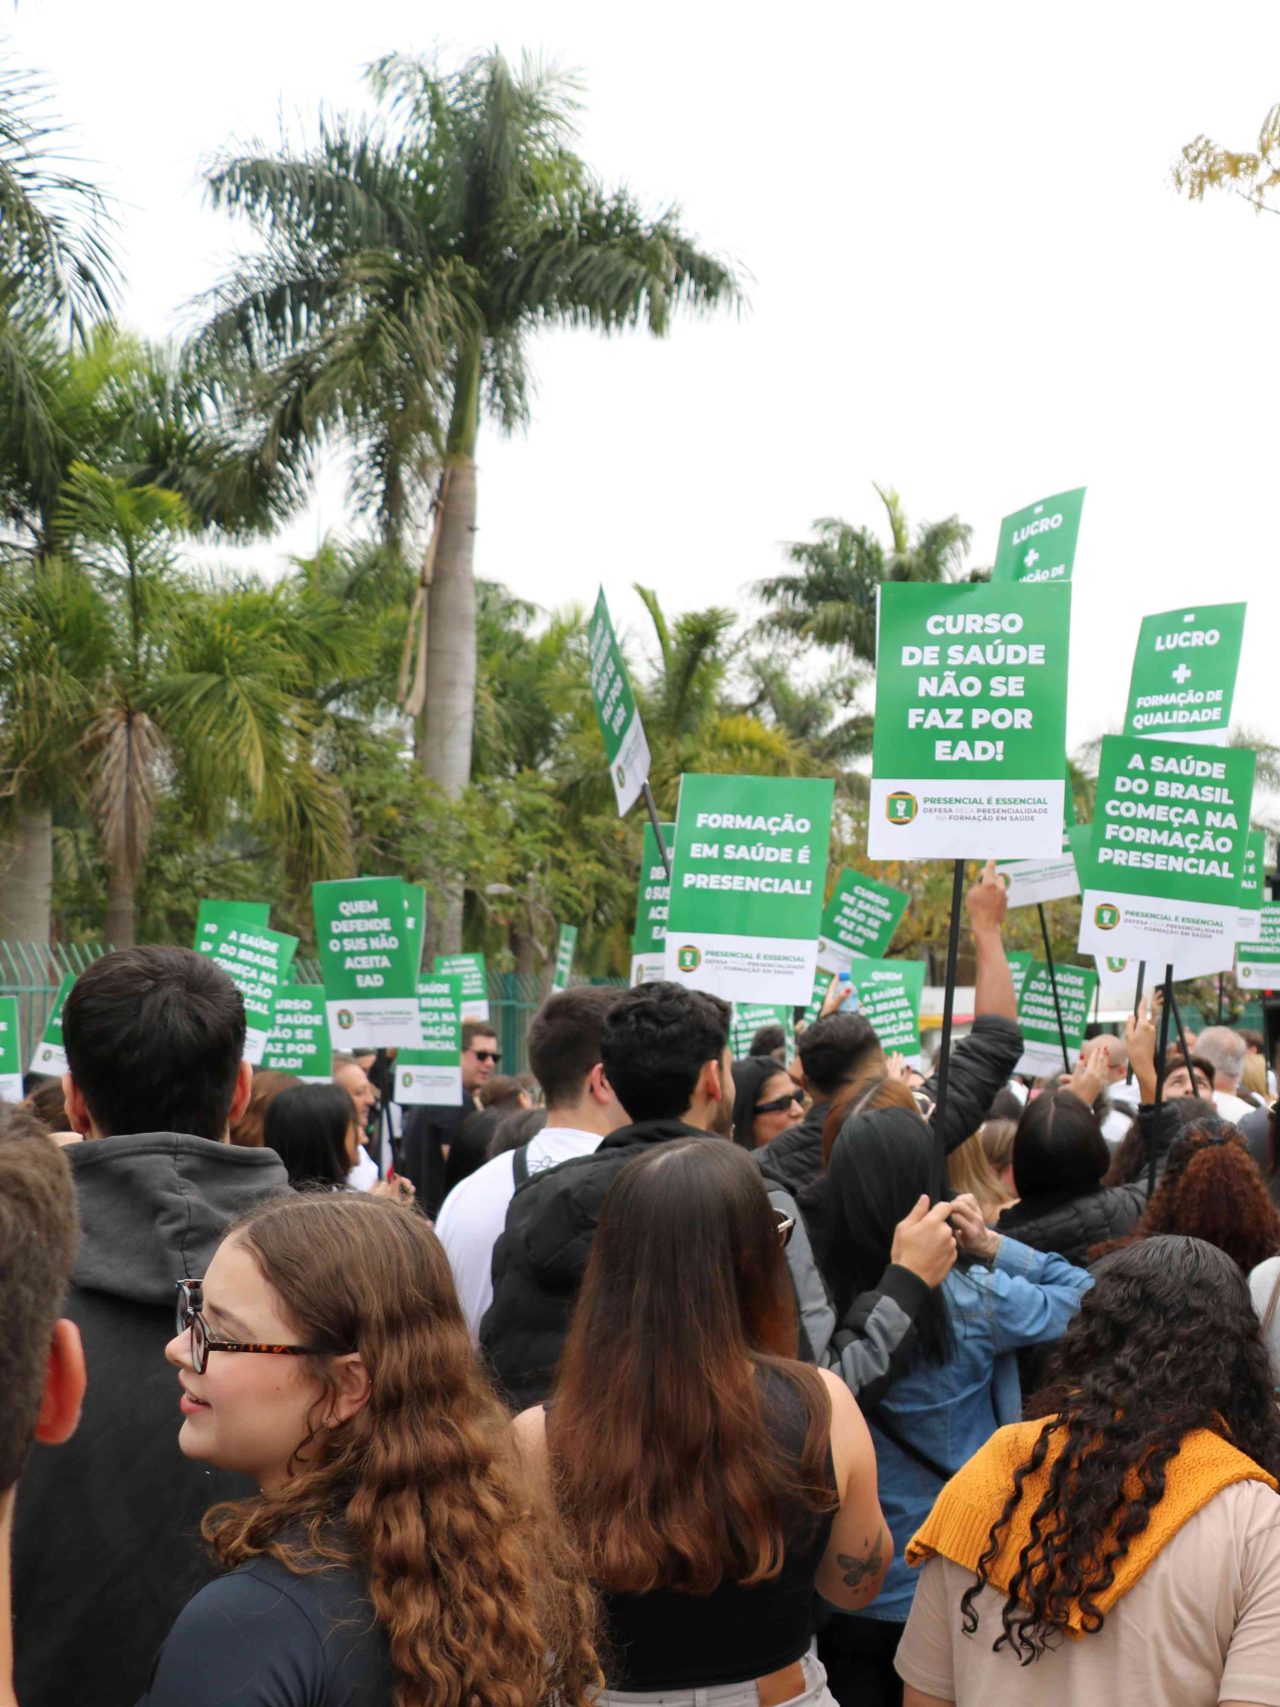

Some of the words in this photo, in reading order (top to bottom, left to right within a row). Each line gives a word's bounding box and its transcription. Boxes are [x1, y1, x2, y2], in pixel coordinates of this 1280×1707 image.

[1012, 513, 1063, 545] LUCRO
[926, 613, 1023, 636] CURSO
[1155, 630, 1220, 652] LUCRO
[902, 645, 940, 666] DE
[947, 639, 1045, 666] SAÚDE
[918, 671, 980, 698] NÃO
[989, 676, 1025, 698] SE
[1136, 690, 1204, 708] FORMAÇÃO
[1206, 690, 1223, 702] DE
[908, 708, 964, 729] FAZ
[971, 708, 1033, 730] POR
[1132, 707, 1222, 729] QUALIDADE
[934, 740, 1005, 762] EAD!
[1127, 754, 1144, 771] A
[1150, 755, 1226, 779] SAÚDE
[923, 797, 984, 805] PRESENCIAL
[987, 795, 993, 805] É
[995, 797, 1048, 805] ESSENCIAL
[1115, 776, 1149, 795] DO
[1154, 780, 1234, 805] BRASIL
[696, 813, 811, 835] FORMAÇÃO
[948, 813, 993, 823] FORMAÇÃO
[1009, 813, 1035, 822] SAÚDE
[1105, 799, 1199, 828] COMEÇA
[1205, 811, 1238, 830] NA
[1105, 824, 1232, 853] FORMAÇÃO
[690, 843, 719, 858] EM
[723, 842, 792, 863] SAÚDE
[797, 845, 810, 864] É
[1098, 847, 1234, 878] PRESENCIAL
[683, 873, 812, 895] PRESENCIAL!
[840, 892, 857, 904] DE
[857, 900, 893, 922] SAÚDE
[853, 885, 889, 907] CURSO
[339, 900, 378, 916] QUEM
[841, 905, 866, 922] NÃO
[866, 917, 881, 928] SE
[1124, 909, 1173, 922] PRESENCIAL
[1181, 916, 1224, 928] ESSENCIAL
[331, 918, 391, 933] DEFENDE
[834, 915, 856, 930] FAZ
[855, 925, 879, 940] POR
[228, 931, 237, 941] A
[239, 933, 279, 953] SAÚDE
[329, 940, 340, 952] O
[342, 937, 368, 950] SUS
[369, 934, 398, 949] NÃO
[219, 943, 236, 956] DO
[237, 948, 279, 970] BRASIL
[345, 955, 391, 969] ACEITA
[705, 951, 753, 960] PRESENCIAL
[763, 954, 805, 962] ESSENCIAL
[259, 971, 278, 984] NA
[356, 975, 384, 987] EAD
[1038, 970, 1046, 978] A
[1029, 981, 1046, 991] DO
[876, 998, 910, 1012] BRASIL
[898, 1009, 914, 1019] NA
[1070, 1001, 1086, 1012] NA
[275, 1013, 323, 1025] SAÚDE
[295, 1028, 313, 1040] SE
[265, 1043, 283, 1054] AZ
[286, 1043, 317, 1054] POR
[269, 1057, 303, 1069] EAD!
